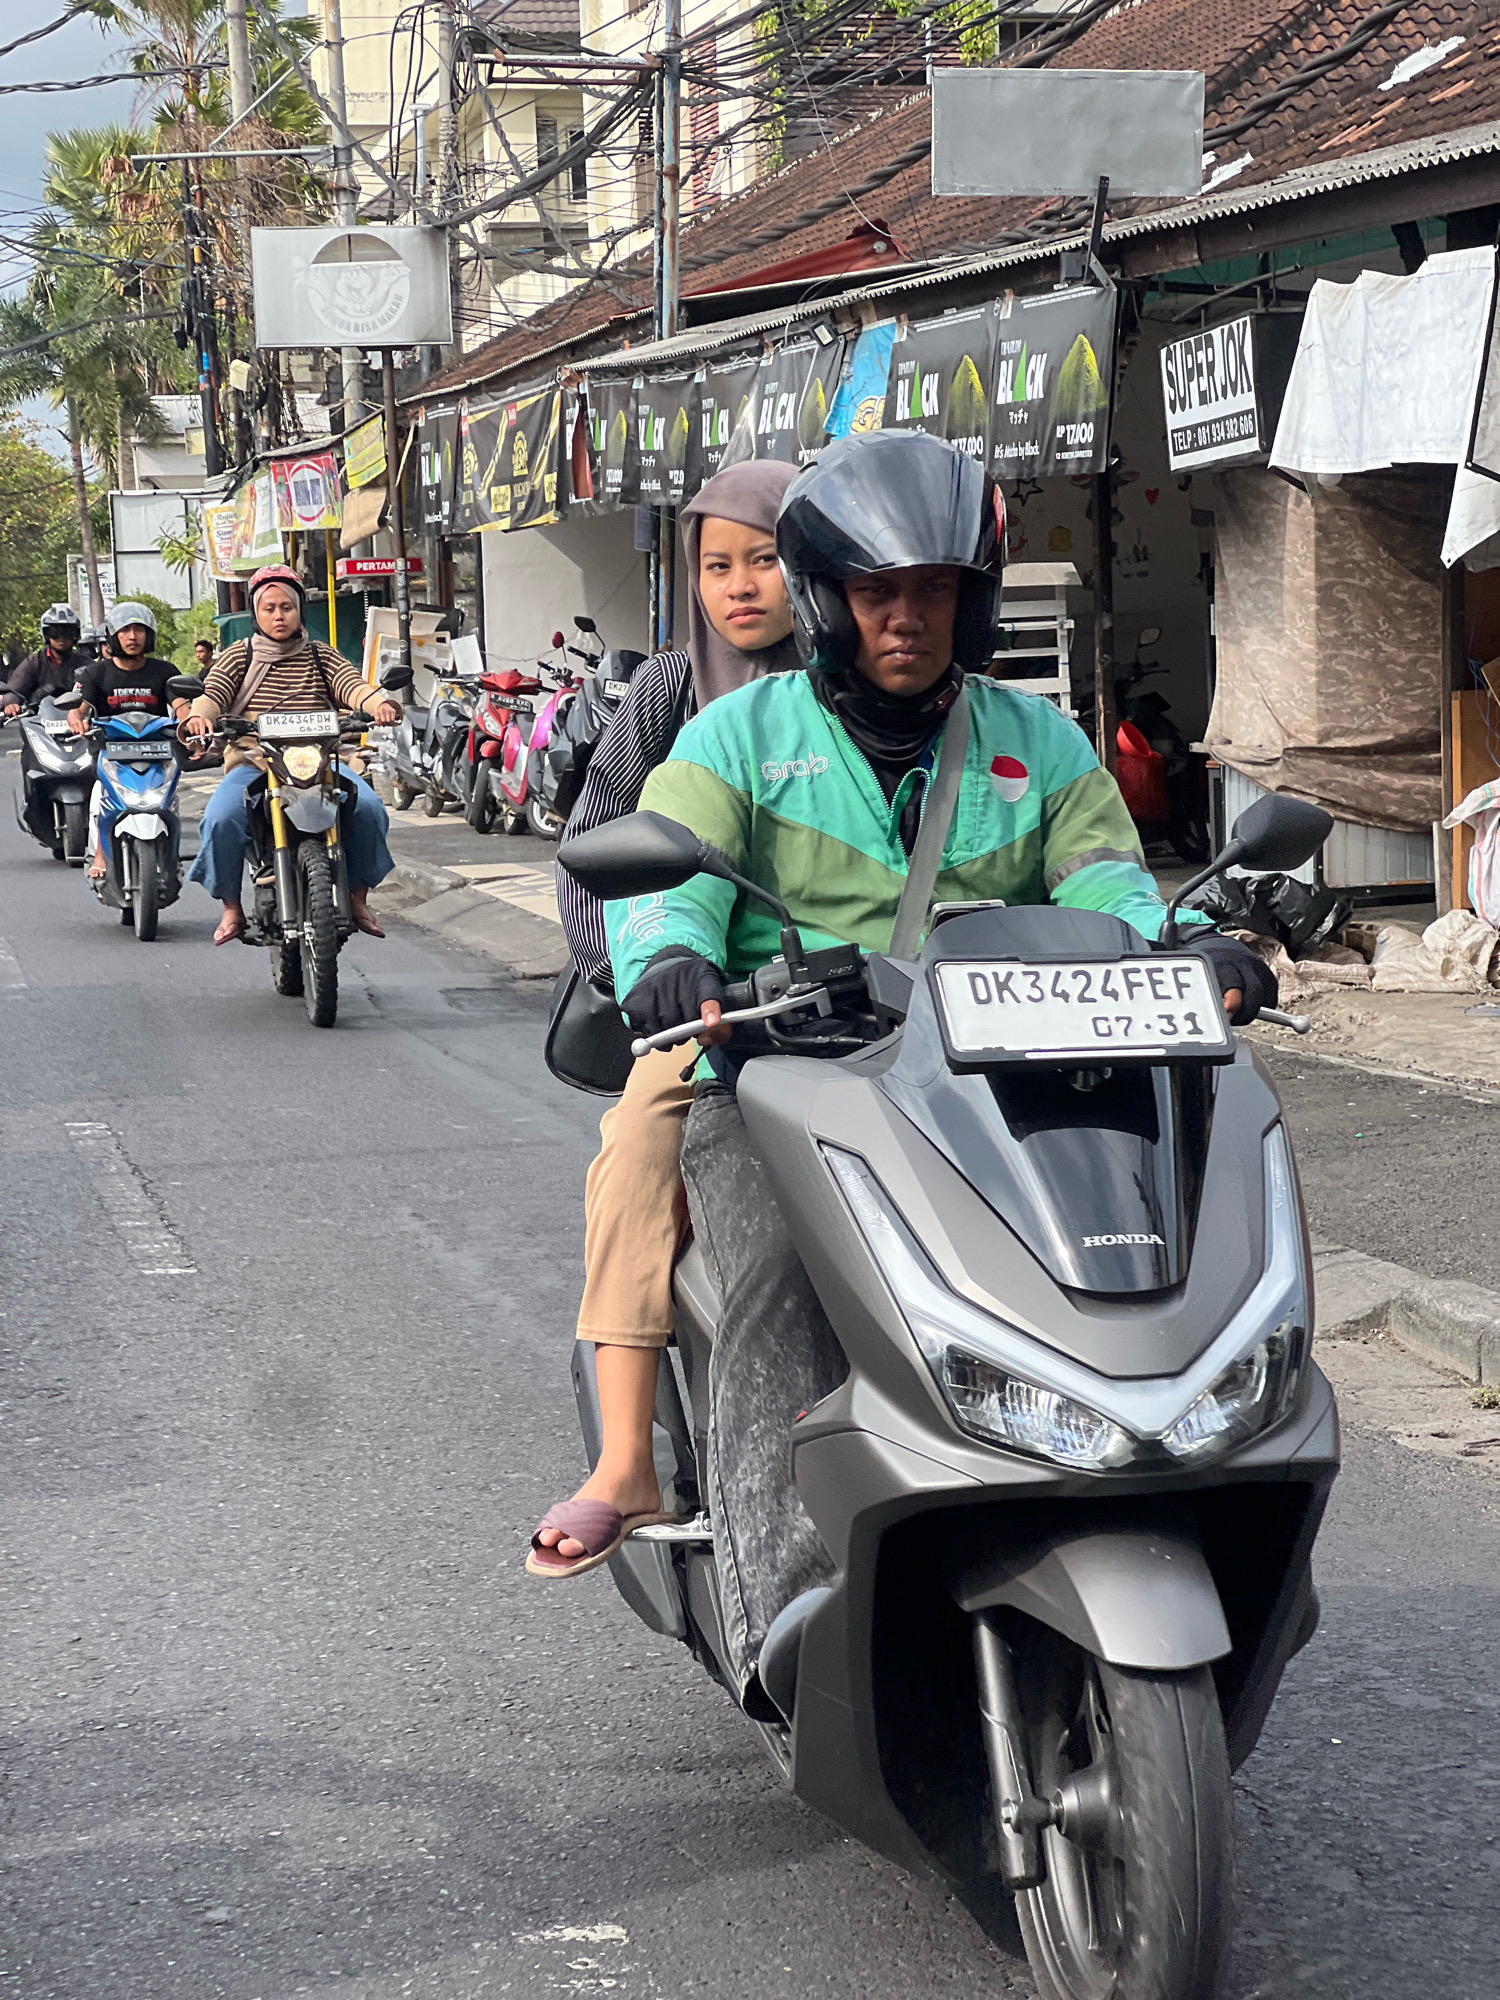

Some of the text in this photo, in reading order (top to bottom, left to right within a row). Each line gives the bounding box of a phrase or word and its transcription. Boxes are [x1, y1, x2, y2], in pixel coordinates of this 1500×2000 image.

[1165, 319, 1253, 415] SUPER JOK
[1172, 429, 1192, 452] TELP
[1197, 424, 1211, 447] 081
[1211, 422, 1225, 443] 934
[1226, 419, 1240, 439] 382
[1239, 413, 1254, 436] 606
[118, 687, 152, 697] DEKADE
[266, 714, 331, 725] DK2434FDW
[761, 752, 828, 781] Grab
[967, 966, 1193, 1005] DK3424FEF
[1082, 1233, 1166, 1248] HONDA
